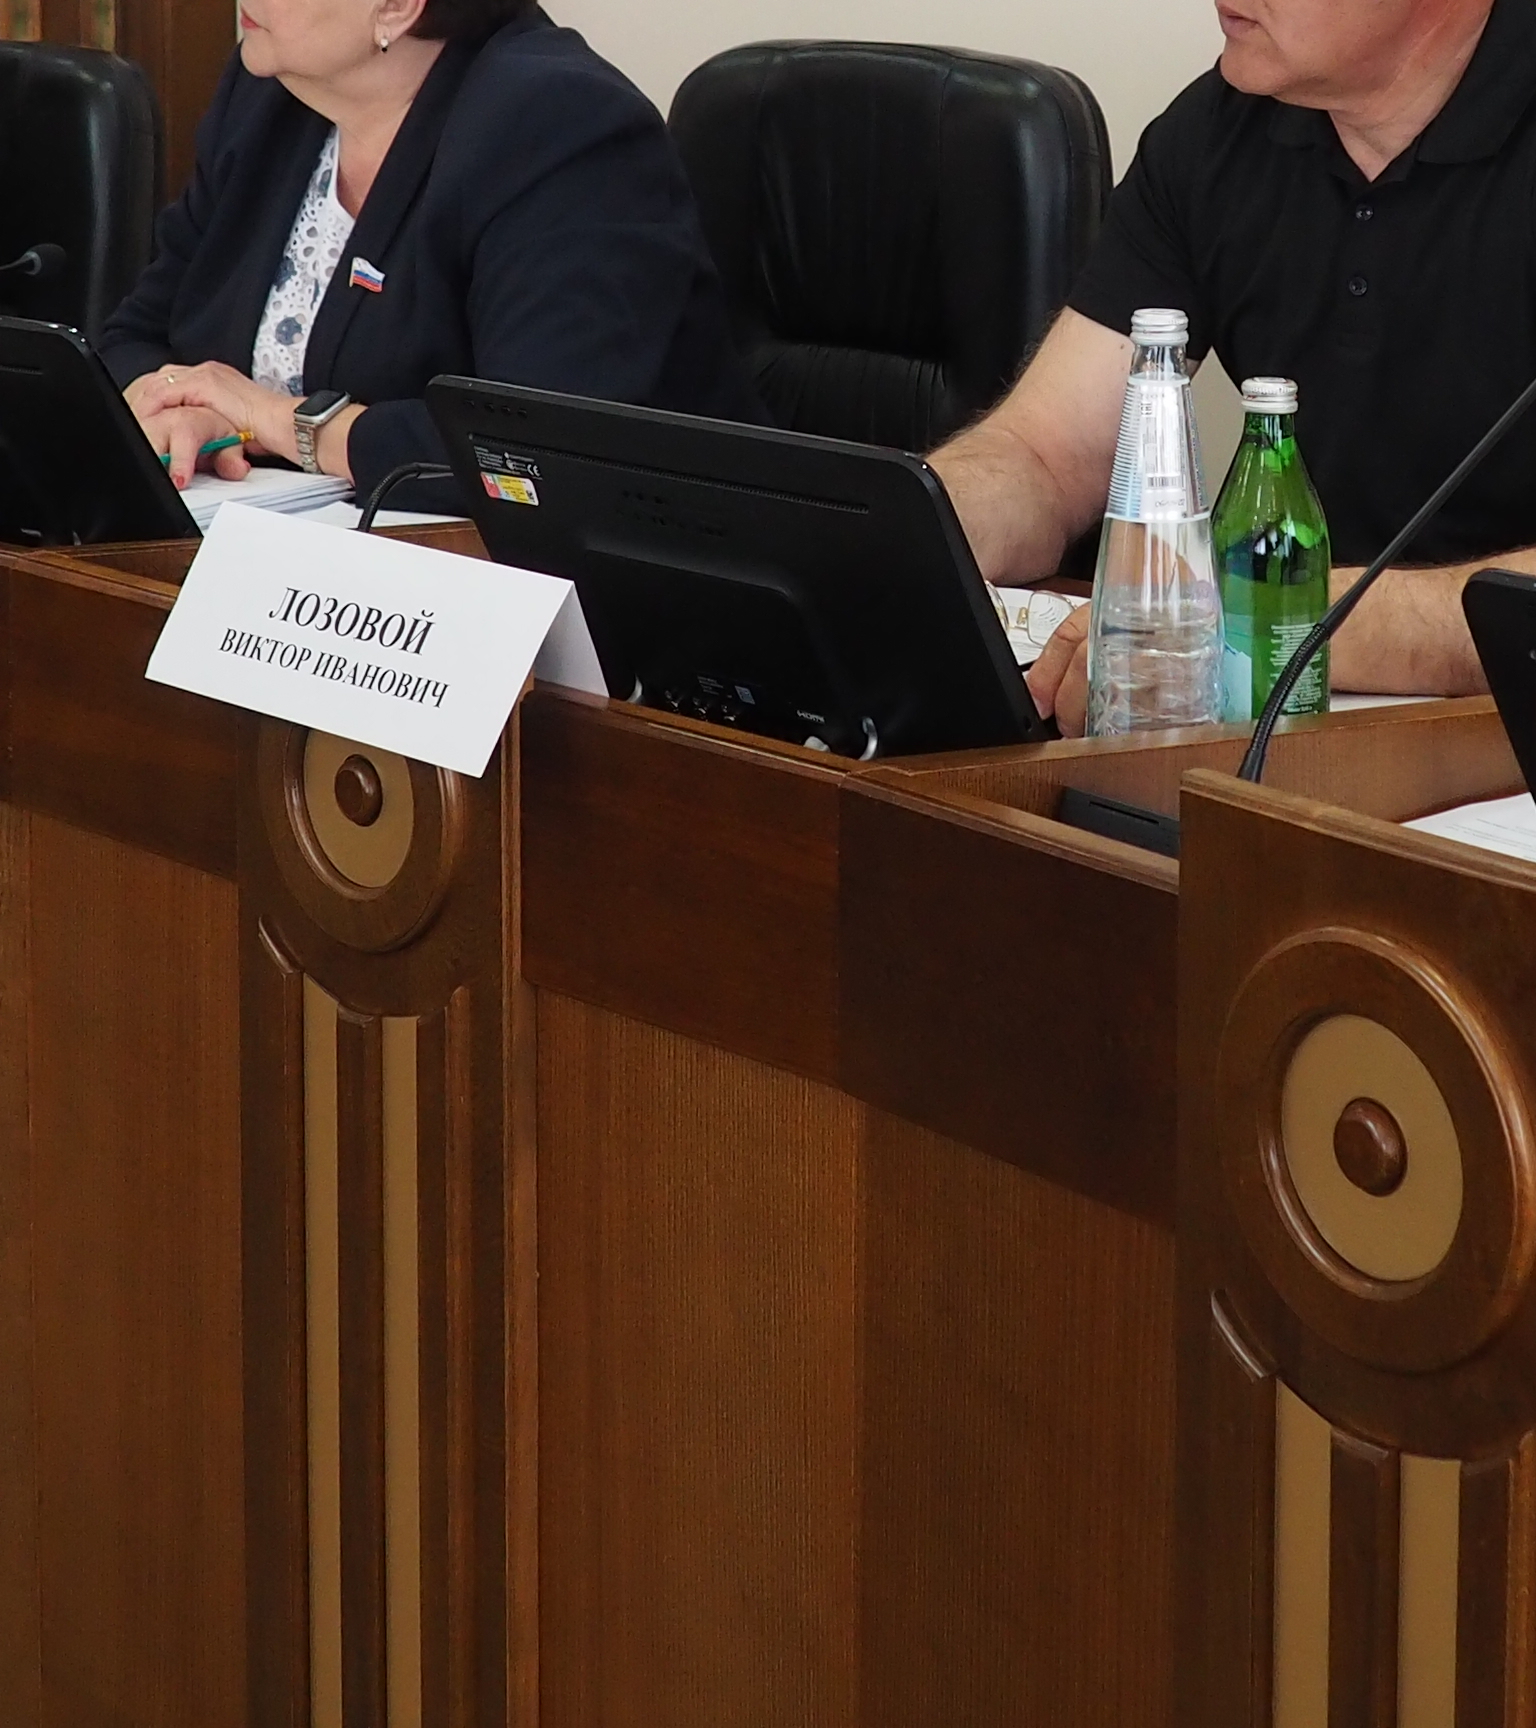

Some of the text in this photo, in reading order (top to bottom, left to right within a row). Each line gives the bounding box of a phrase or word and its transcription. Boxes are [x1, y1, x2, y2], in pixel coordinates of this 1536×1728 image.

[268, 587, 436, 656] ЛОЗОВОЙ
[218, 627, 451, 708] ВИКТОР ИВАНОВИЧ
